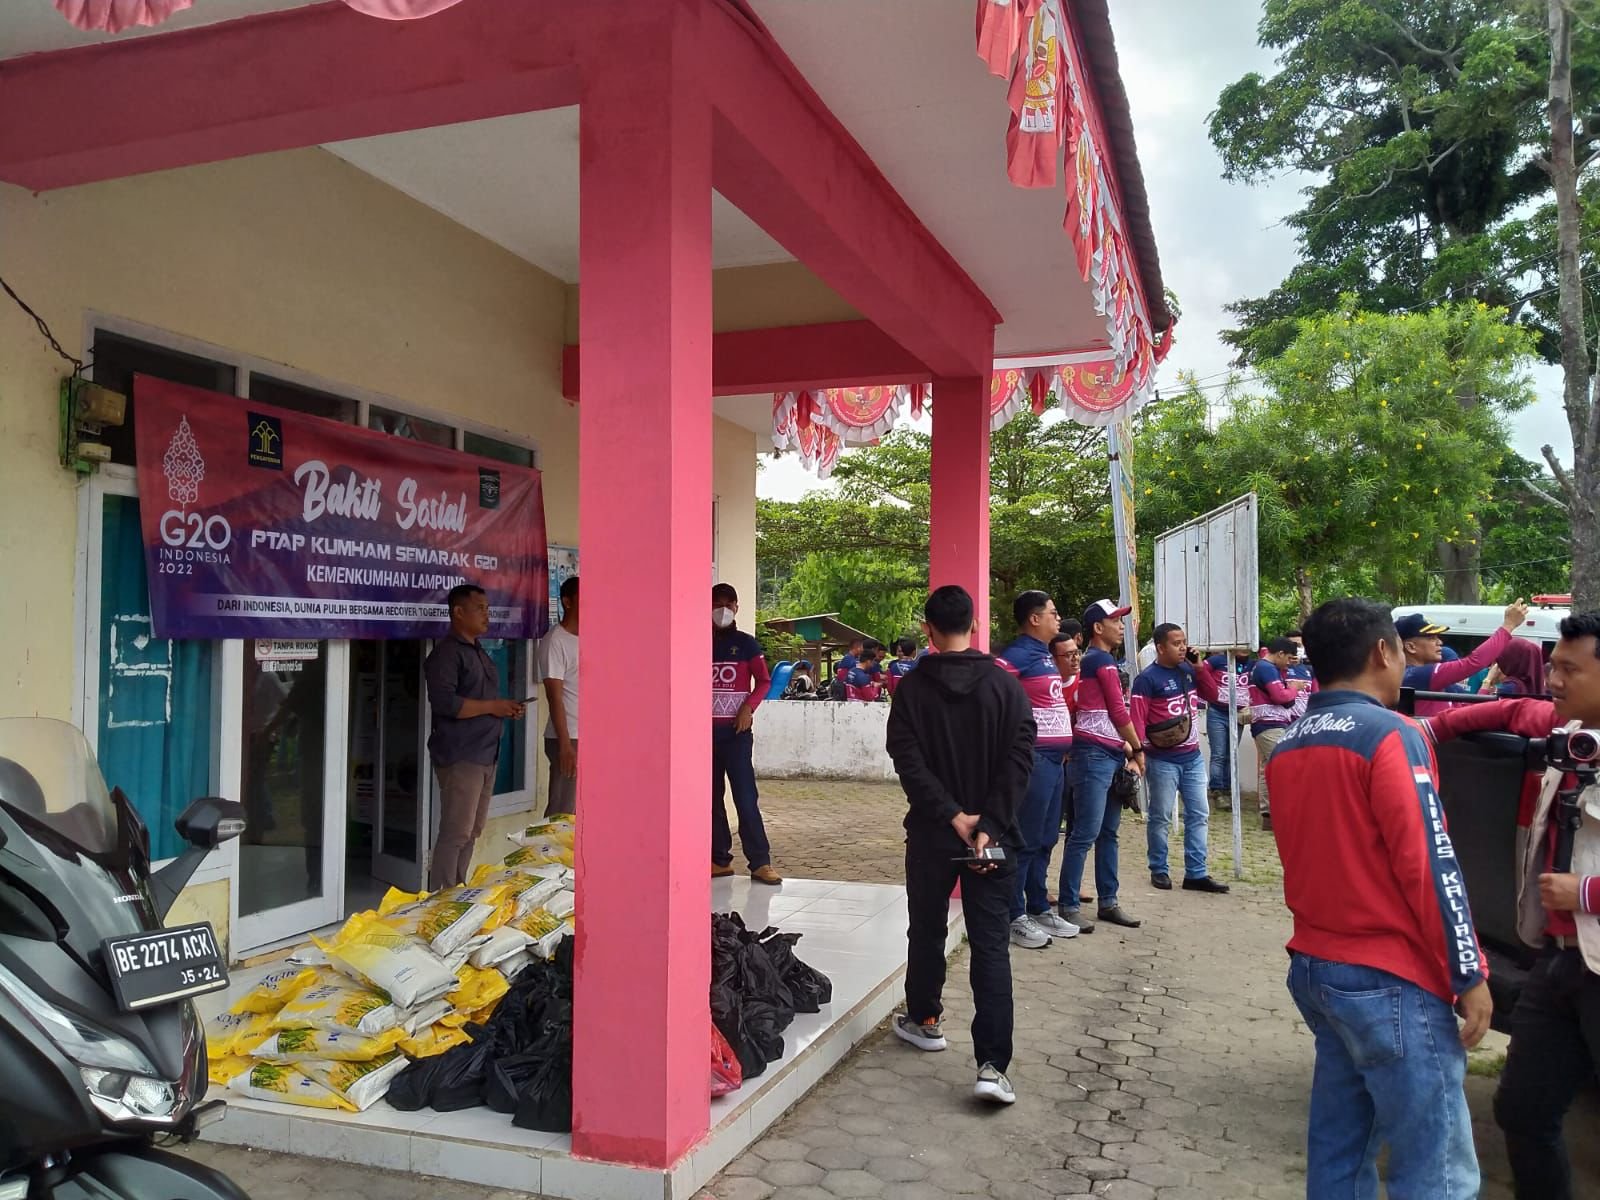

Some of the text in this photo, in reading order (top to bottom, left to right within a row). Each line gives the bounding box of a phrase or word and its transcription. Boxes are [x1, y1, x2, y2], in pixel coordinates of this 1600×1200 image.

[294, 460, 468, 534] Bakti Sosial
[160, 510, 231, 550] G20
[159, 548, 231, 564] INDONESIA
[251, 529, 498, 570] PTAP KUMHAM SEMARAK G20
[159, 562, 193, 575] 2022
[307, 565, 409, 588] KEMENKUMHAN
[217, 599, 241, 611] DARI
[243, 601, 293, 615] INDONESIA,
[294, 602, 321, 614] DUNIA
[323, 603, 348, 615] PULIH
[349, 604, 384, 616] BERSAMA
[385, 606, 417, 617] RECOVER
[418, 607, 449, 618] TOGETHE
[273, 641, 318, 650] TANPA ROKOK
[712, 665, 737, 683] 20
[1311, 712, 1356, 735] Basic
[113, 894, 144, 904] HONDA
[1441, 871, 1479, 975] KALIANDA
[117, 933, 211, 972] BE 2274 ACK
